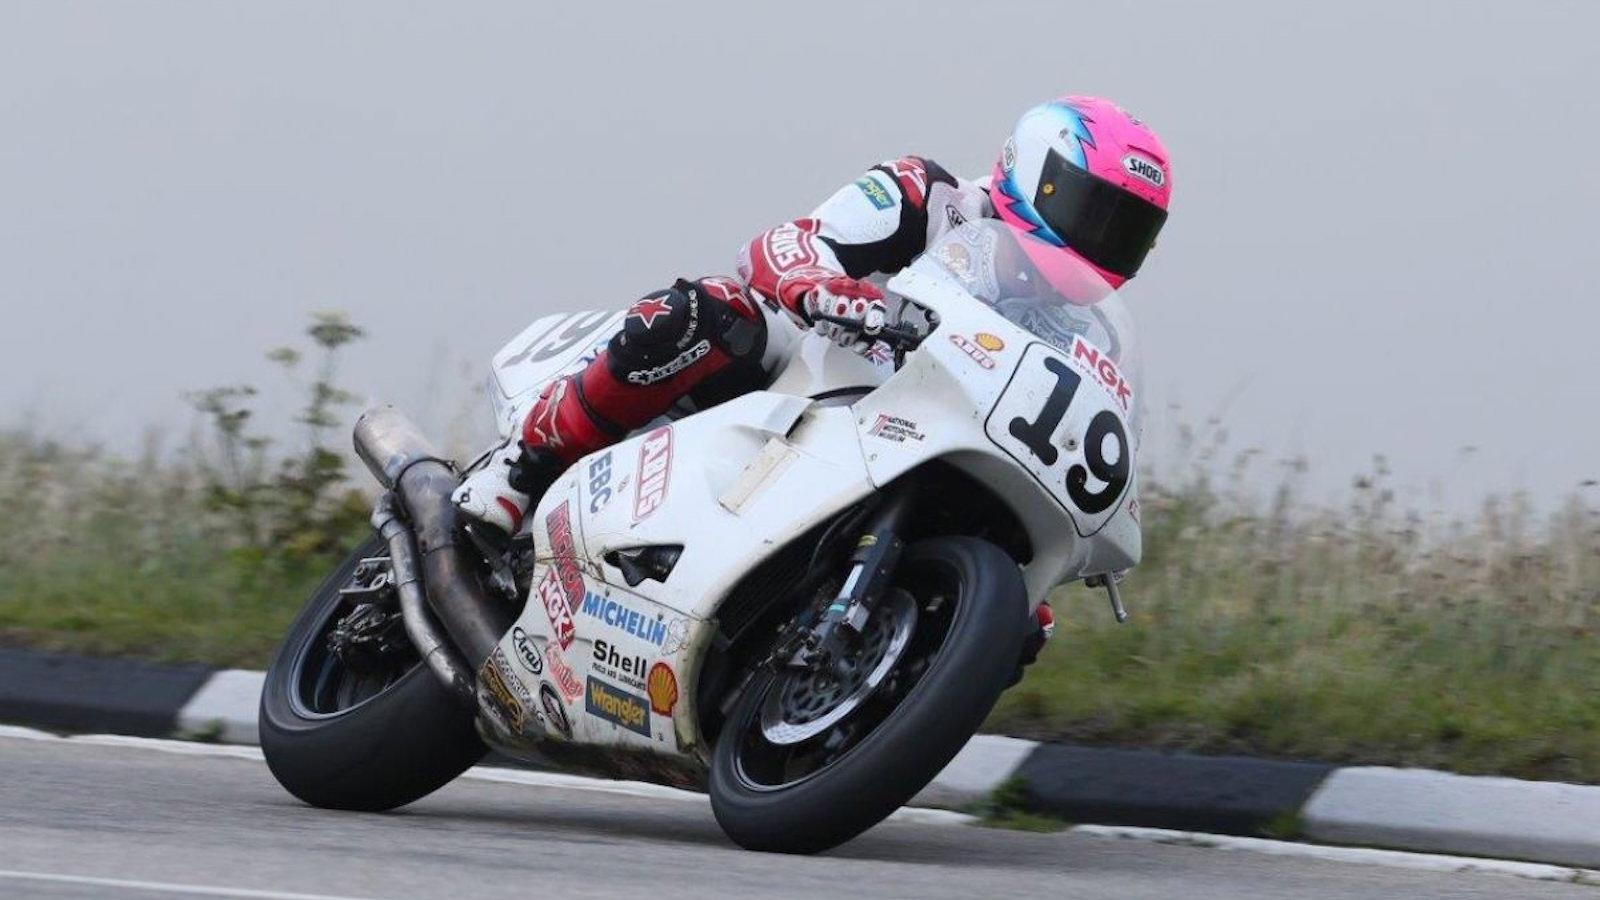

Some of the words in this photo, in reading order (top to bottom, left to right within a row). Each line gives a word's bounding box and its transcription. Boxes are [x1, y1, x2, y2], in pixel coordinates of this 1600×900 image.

[1129, 158, 1162, 185] SHOEI
[1075, 339, 1131, 410] NGK
[1009, 357, 1129, 514] 19
[589, 451, 611, 514] EBC
[636, 432, 669, 518] ABUS
[582, 591, 667, 647] MICHELIN
[516, 634, 541, 670] Arai
[593, 639, 647, 679] Shell
[591, 680, 645, 726] Wrangler
